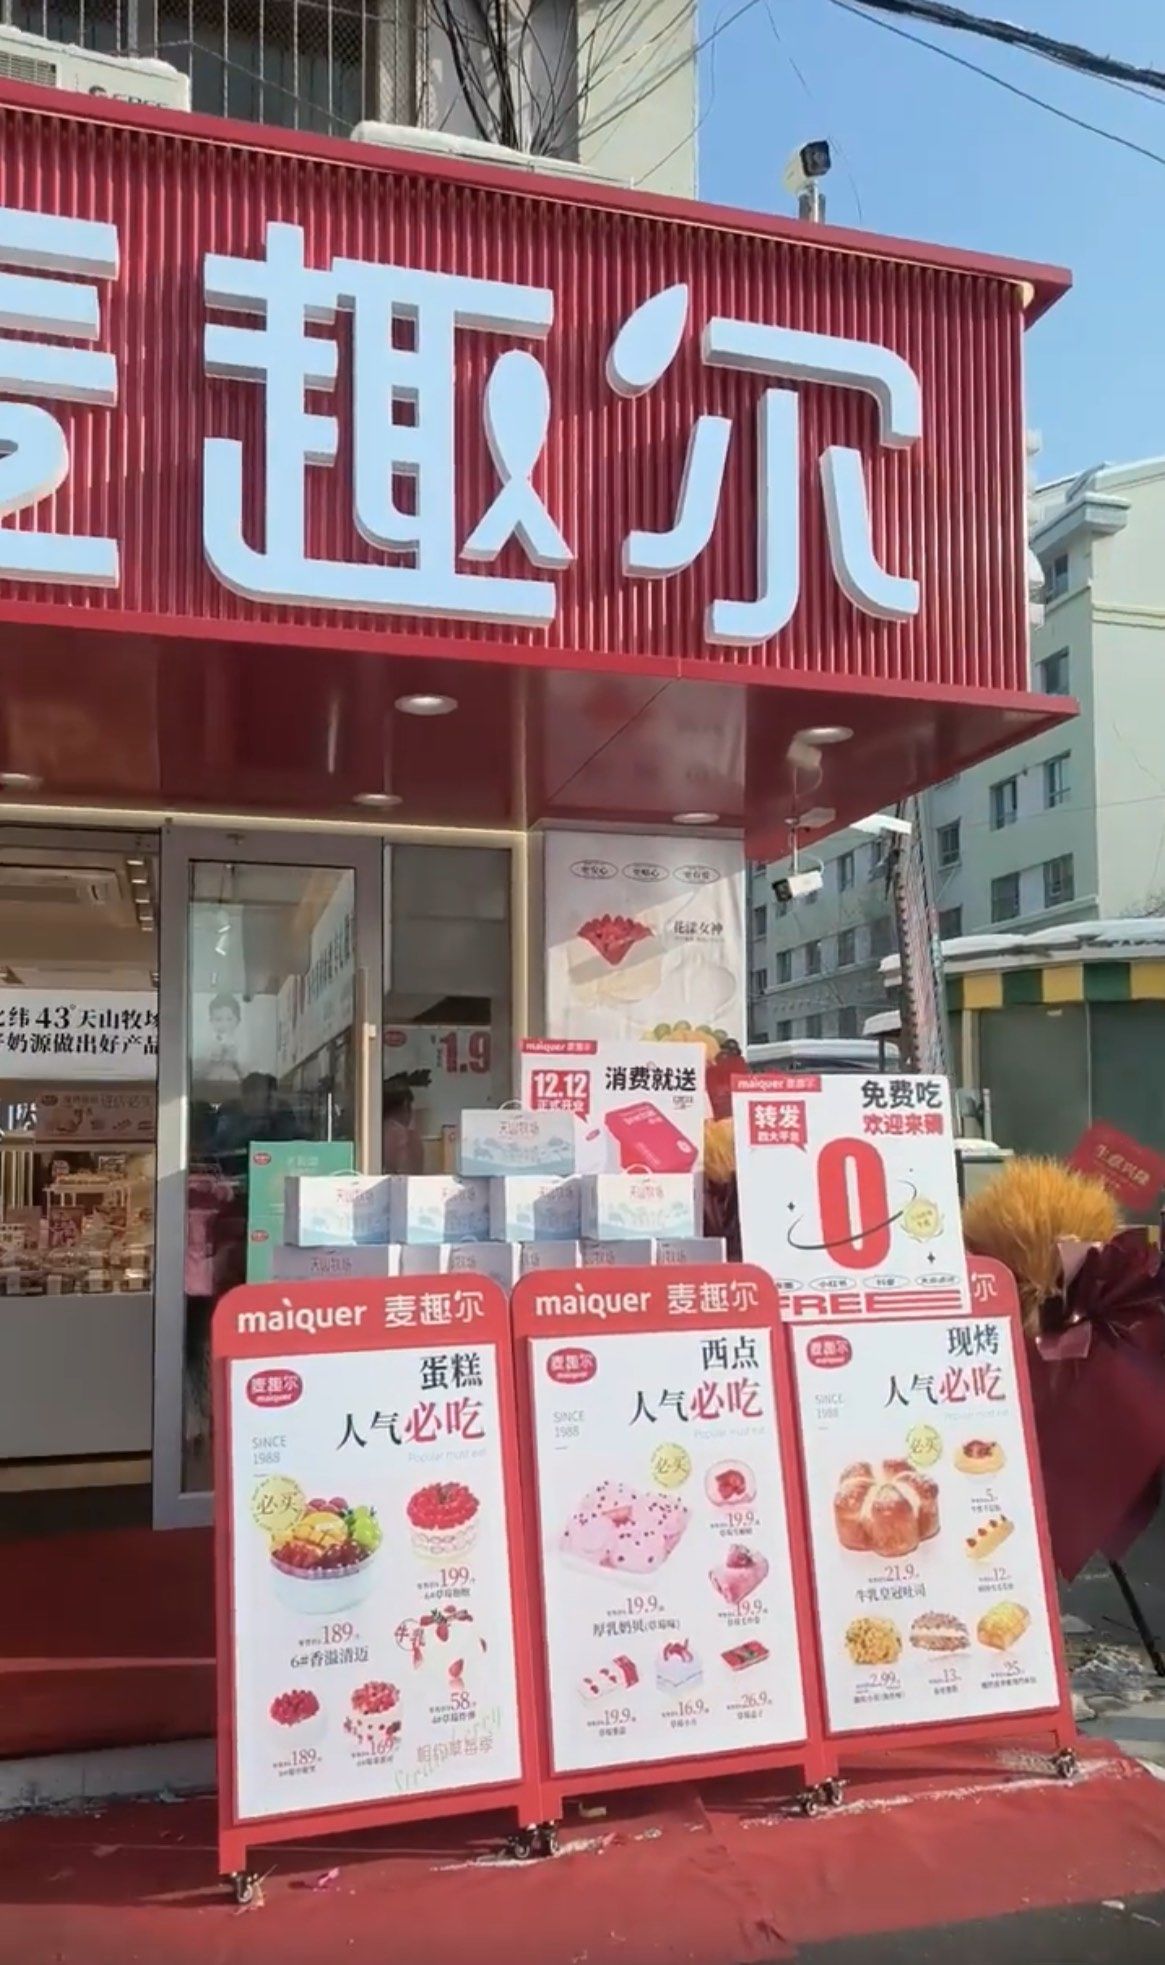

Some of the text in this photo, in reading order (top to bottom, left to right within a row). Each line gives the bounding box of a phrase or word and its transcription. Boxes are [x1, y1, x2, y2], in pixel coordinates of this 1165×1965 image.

[0, 1032, 158, 1055] 奶源做出好产品
[440, 1031, 491, 1074] 1.9
[534, 1072, 587, 1098] 12.12
[605, 1066, 697, 1092] 消费就送
[861, 1080, 943, 1109] 免费吃
[754, 1104, 800, 1128] 转发
[384, 1290, 485, 1328] 麦趣尔
[667, 1280, 759, 1315] 麦趣尔
[702, 1335, 759, 1371] 西点
[947, 1323, 999, 1357] 现烤
[420, 1352, 483, 1391] 蛋糕
[884, 1363, 1007, 1408] 人气必吃
[553, 1410, 585, 1424] SINCE
[628, 1377, 764, 1426] 人气必吃
[336, 1397, 486, 1451] 人气必吃
[252, 1435, 287, 1450] SINCE
[626, 1594, 658, 1615] 19.9
[322, 1621, 354, 1645] 189
